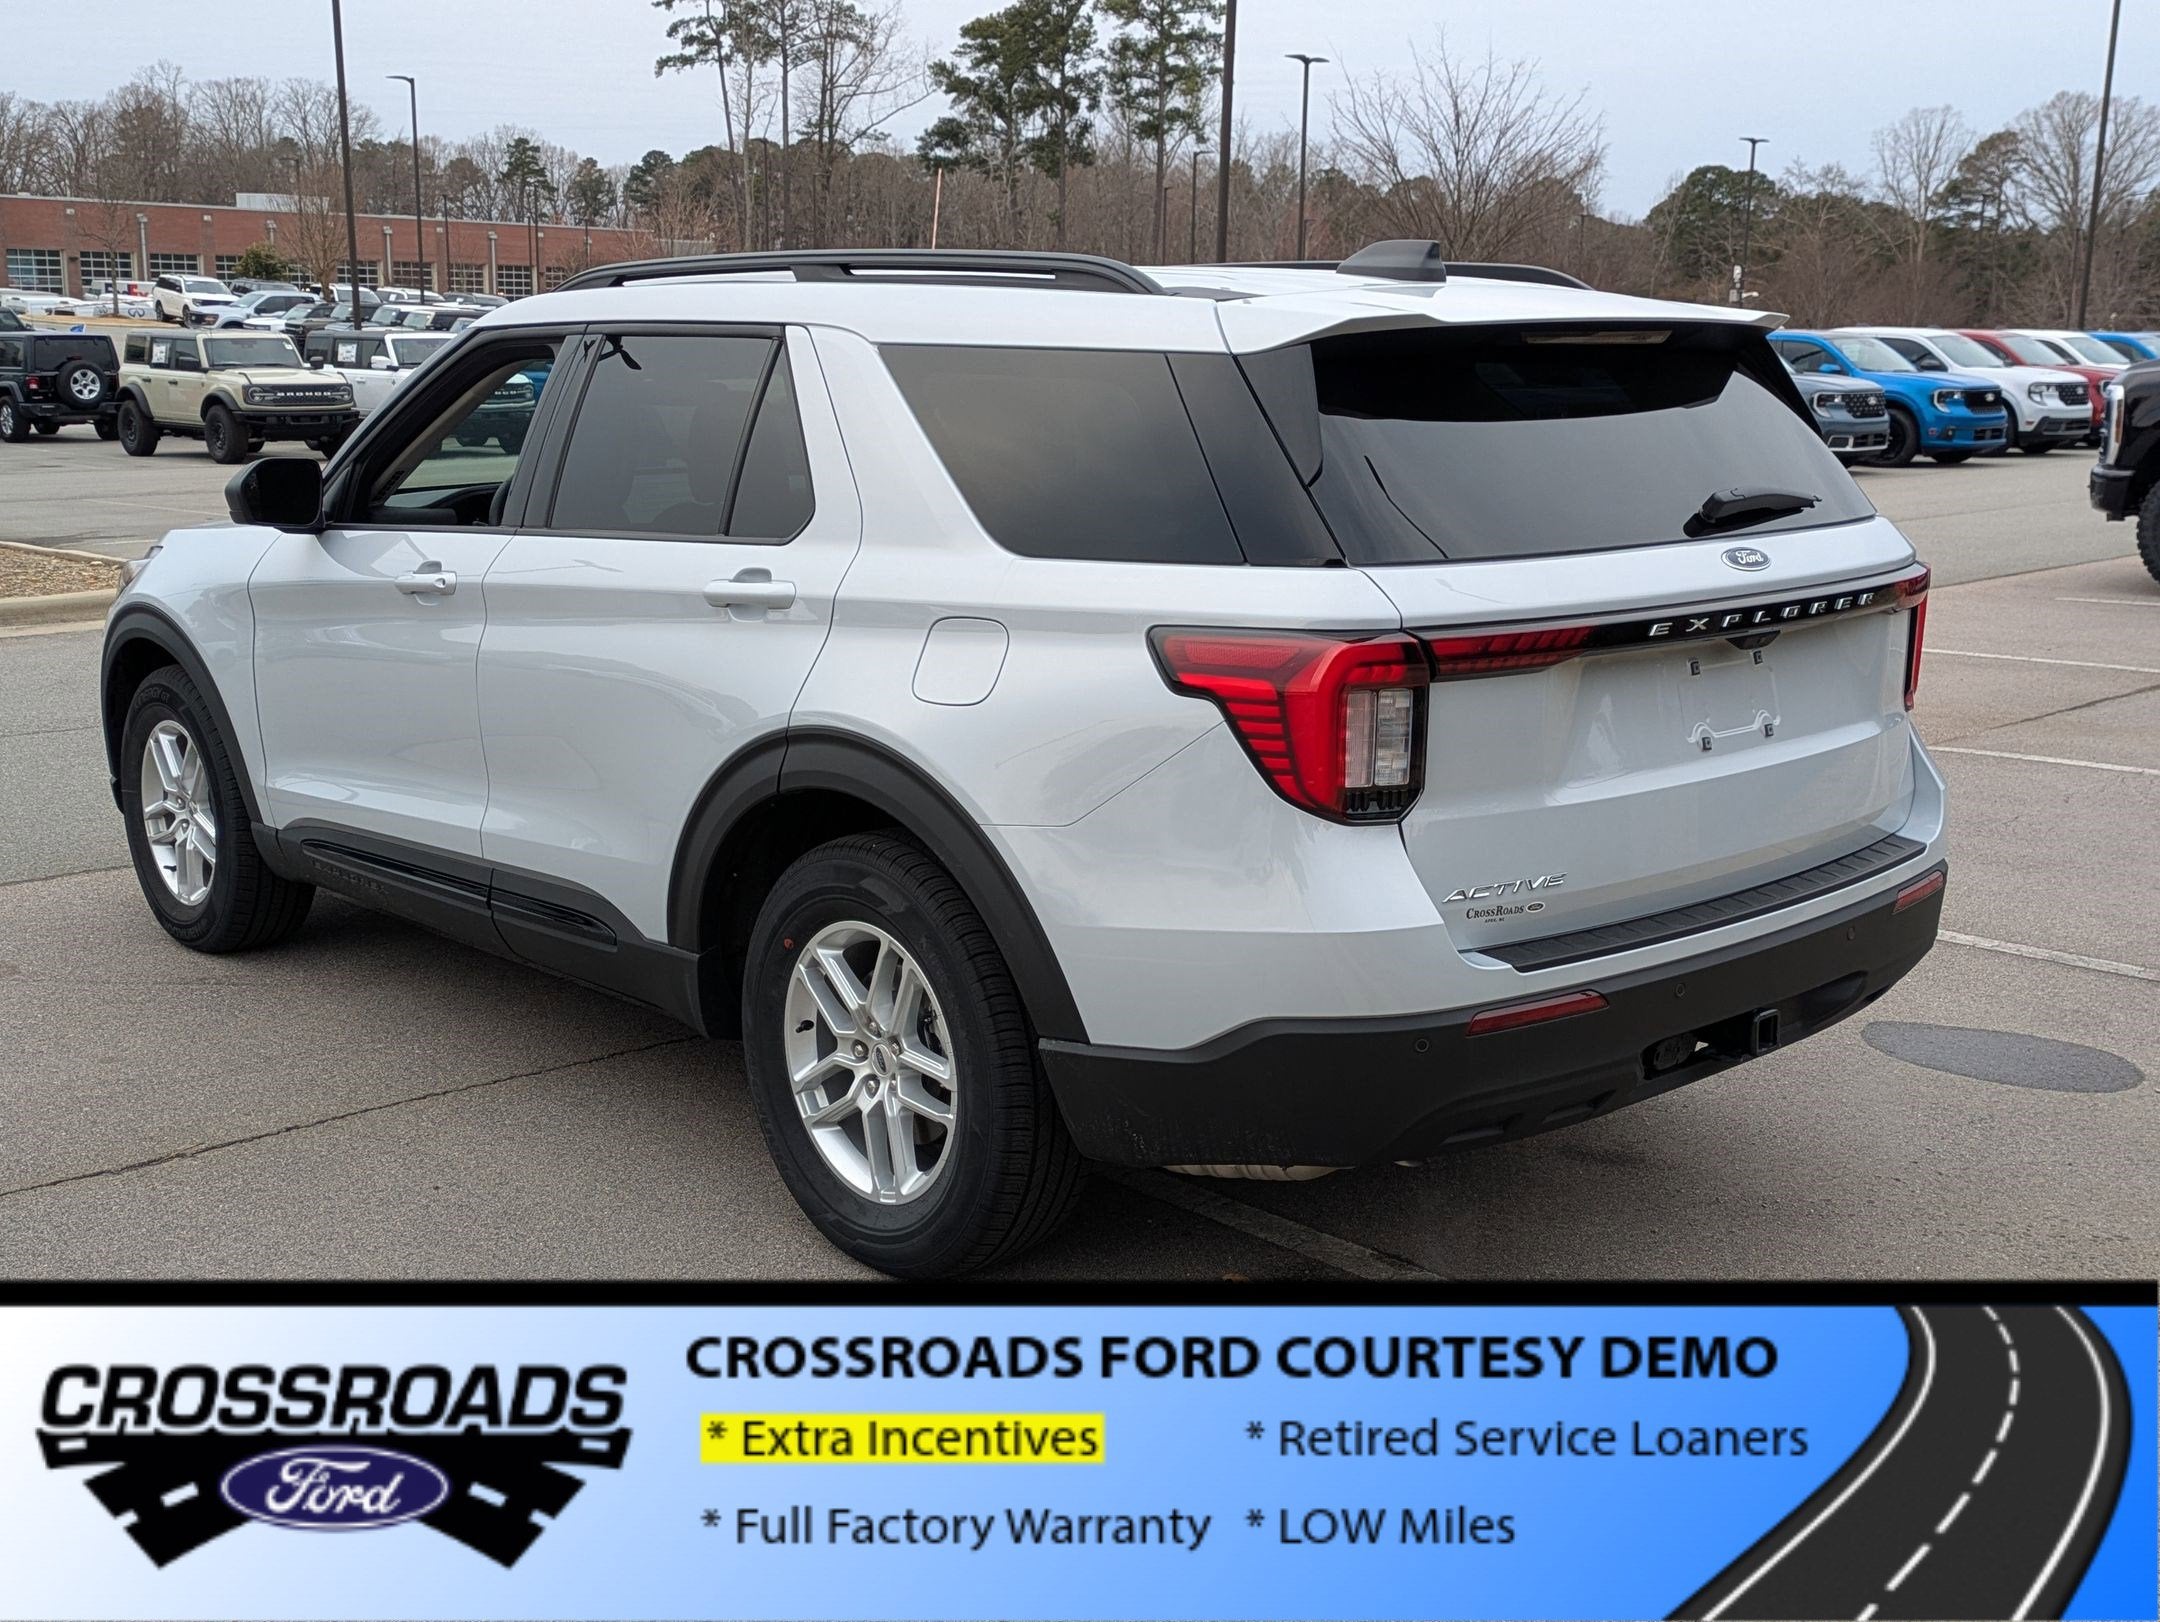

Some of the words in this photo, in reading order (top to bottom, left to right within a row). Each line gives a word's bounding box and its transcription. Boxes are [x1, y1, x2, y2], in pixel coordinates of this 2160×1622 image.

[1735, 550, 1763, 564] Ford
[1648, 592, 1876, 637] EXPLORER
[1442, 872, 1569, 903] ACTIVE
